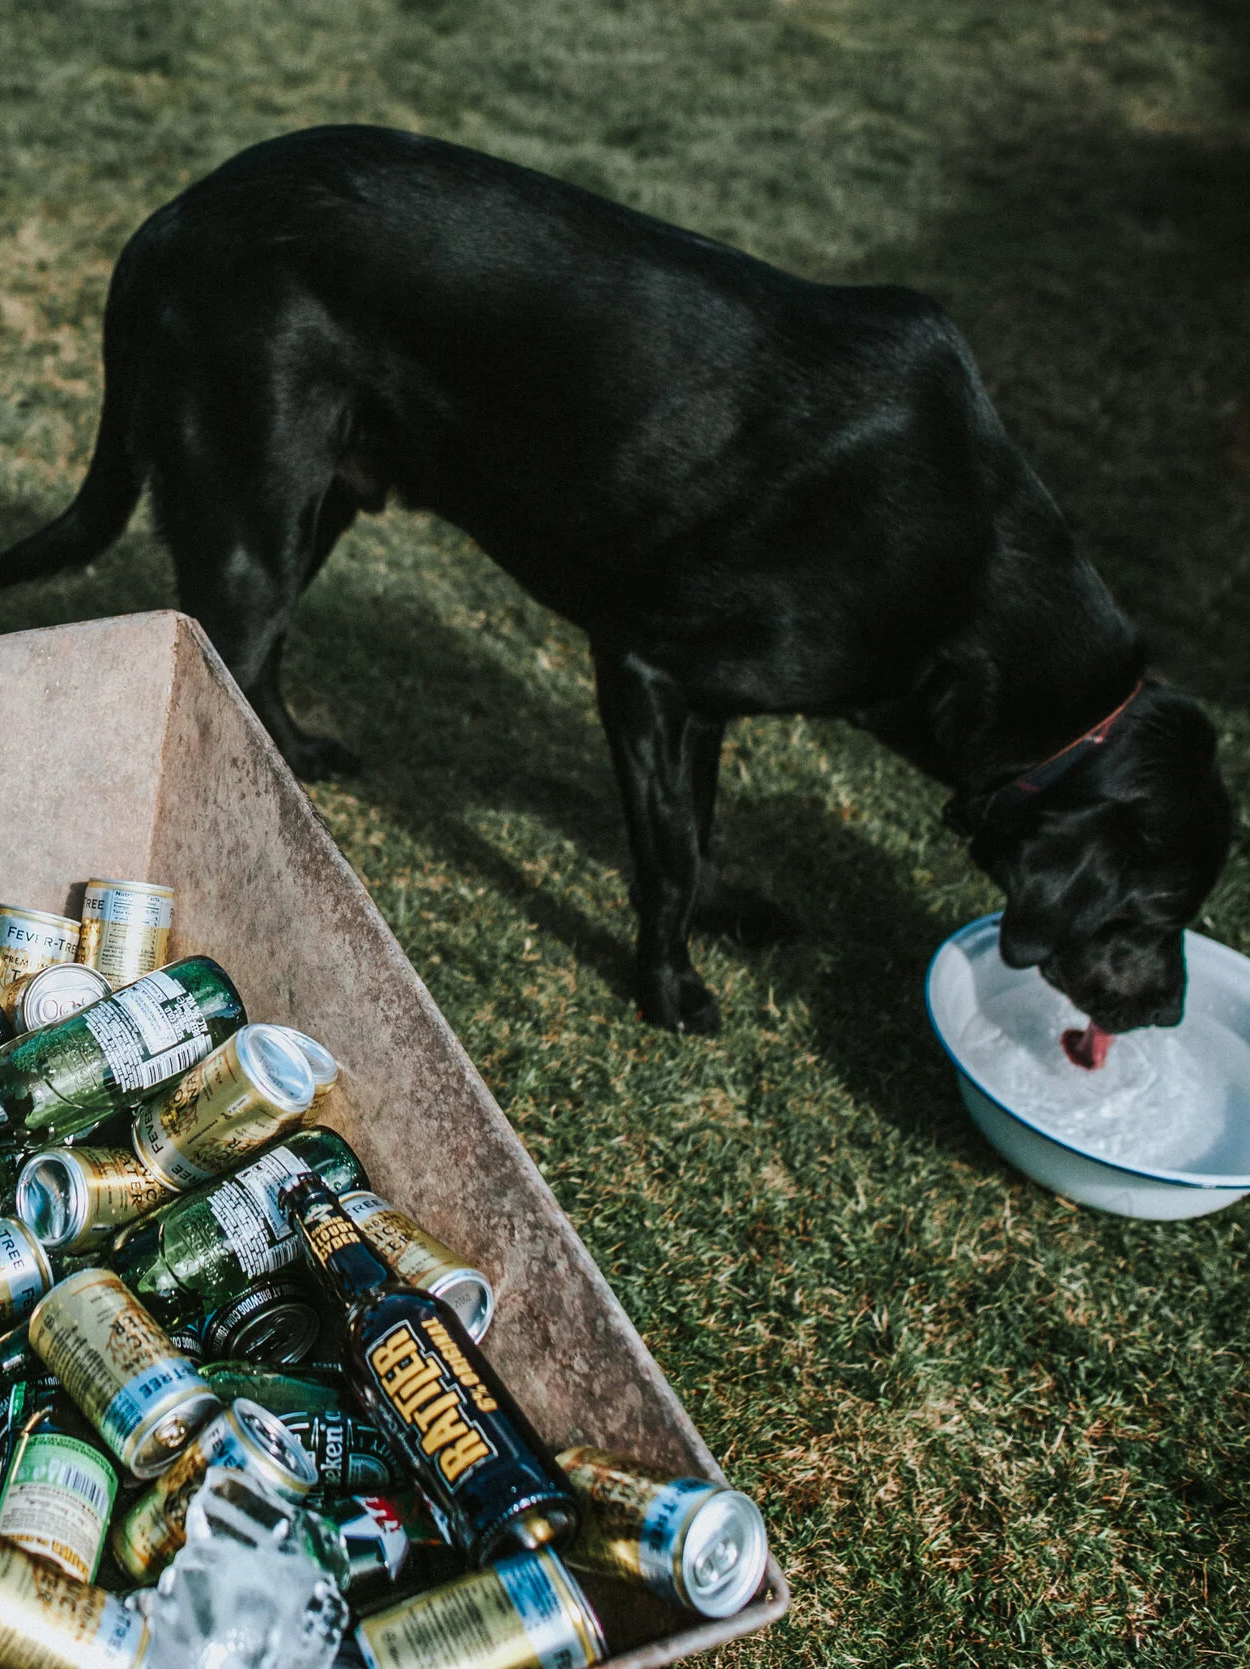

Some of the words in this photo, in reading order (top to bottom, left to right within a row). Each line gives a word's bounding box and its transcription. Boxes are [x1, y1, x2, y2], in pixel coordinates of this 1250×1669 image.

[347, 1199, 383, 1214] REE
[371, 1328, 490, 1482] RATTLER
[321, 1425, 343, 1482] eken
